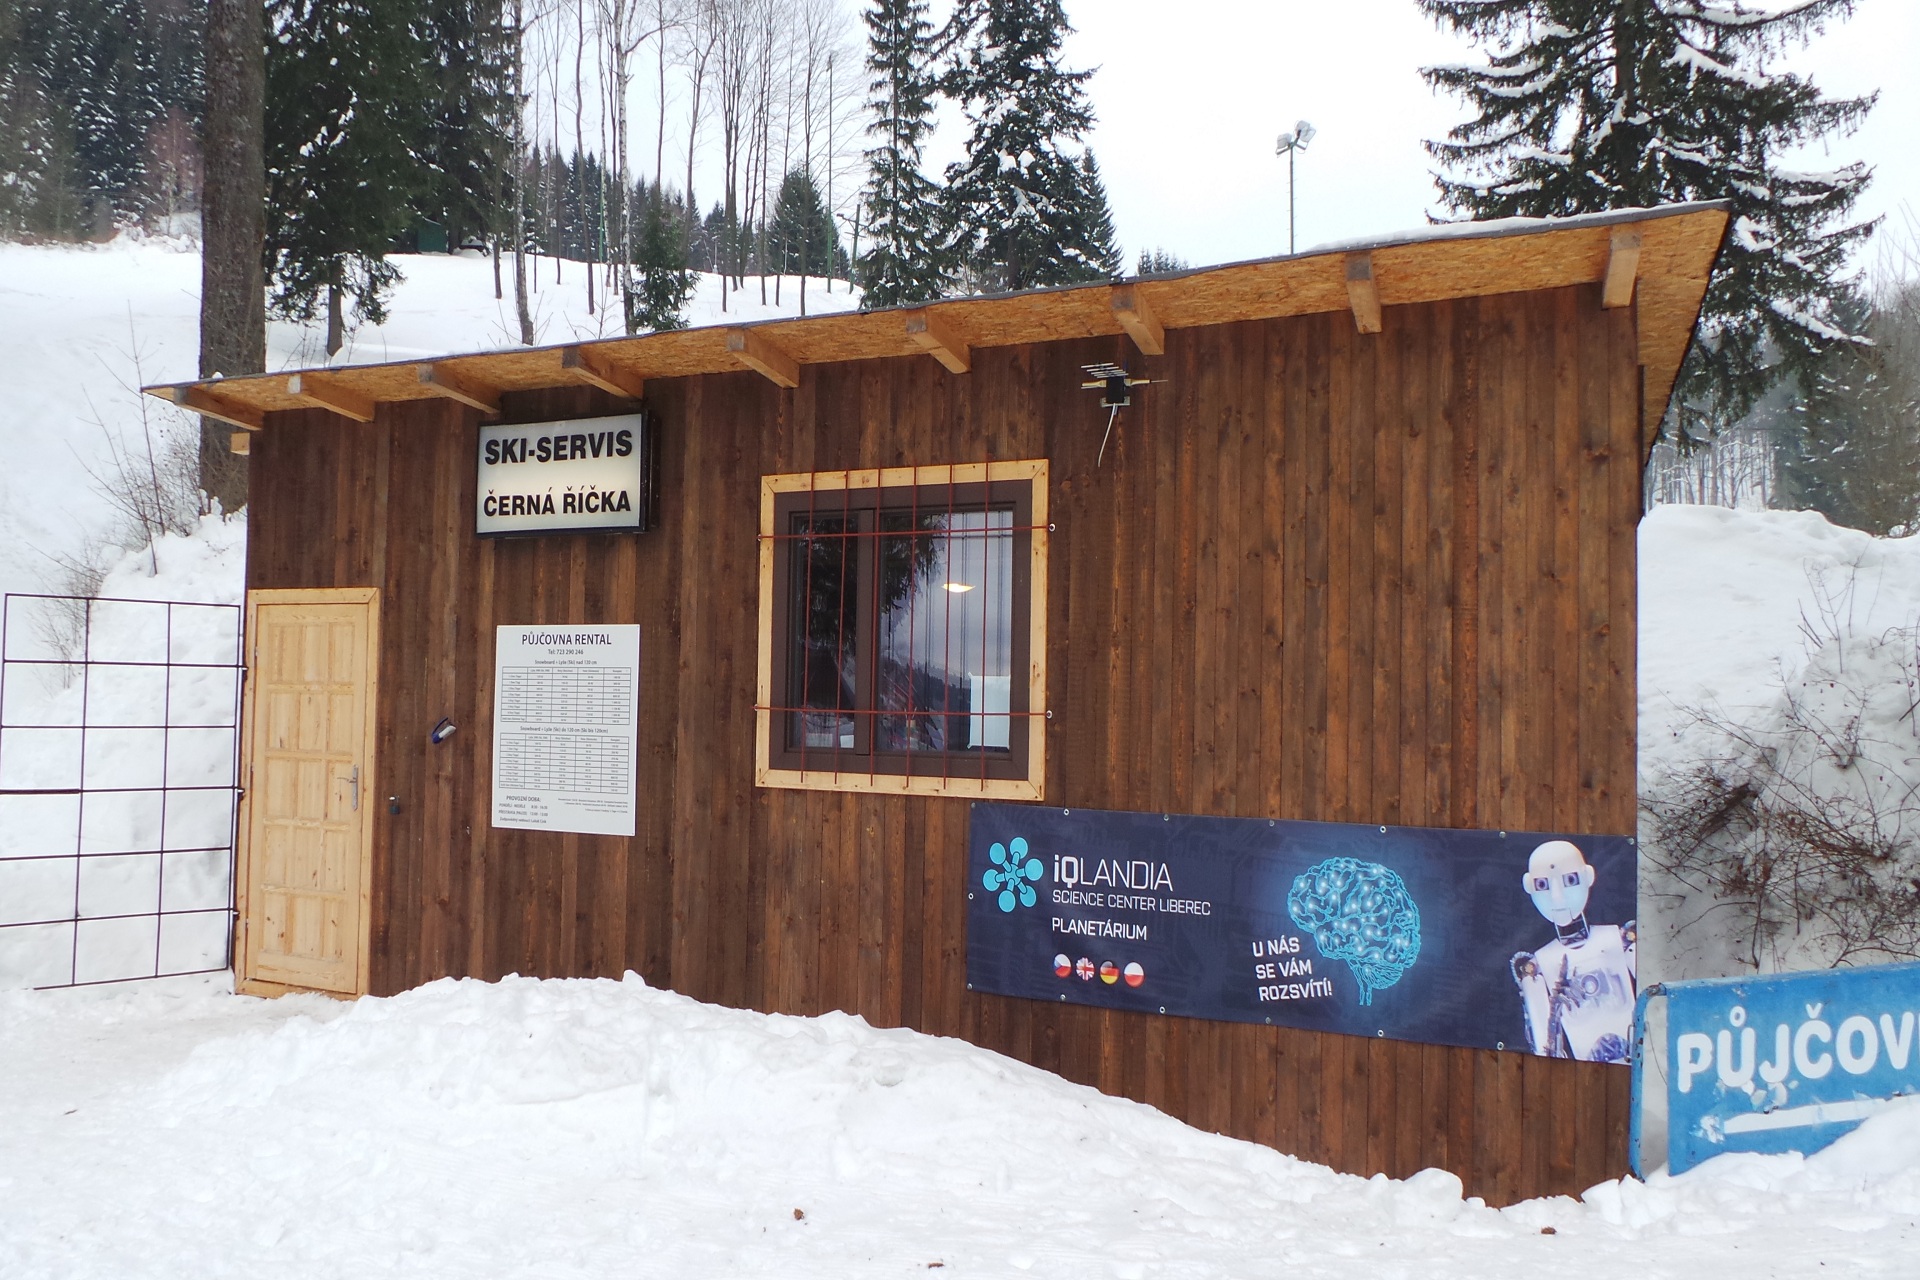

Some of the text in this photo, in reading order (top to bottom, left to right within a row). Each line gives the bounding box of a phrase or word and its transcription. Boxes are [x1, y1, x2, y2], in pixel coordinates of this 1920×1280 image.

[484, 430, 633, 465] SKI-SERVIS
[483, 484, 632, 517] ČERNÁ ŘÍČKA
[522, 631, 612, 645] PŮJČOVNA RENTAL
[1053, 854, 1174, 892] iQLANDIA
[1052, 889, 1211, 916] SCIENCE CENTER LIBEREC
[1052, 917, 1147, 940] PLANETÁRIUM
[1252, 934, 1300, 957] U NÁS
[1255, 957, 1312, 979] SE VÁM
[1258, 977, 1333, 1001] ROZSVÍTÍ!
[1677, 1003, 1920, 1093] PŮJČOV
